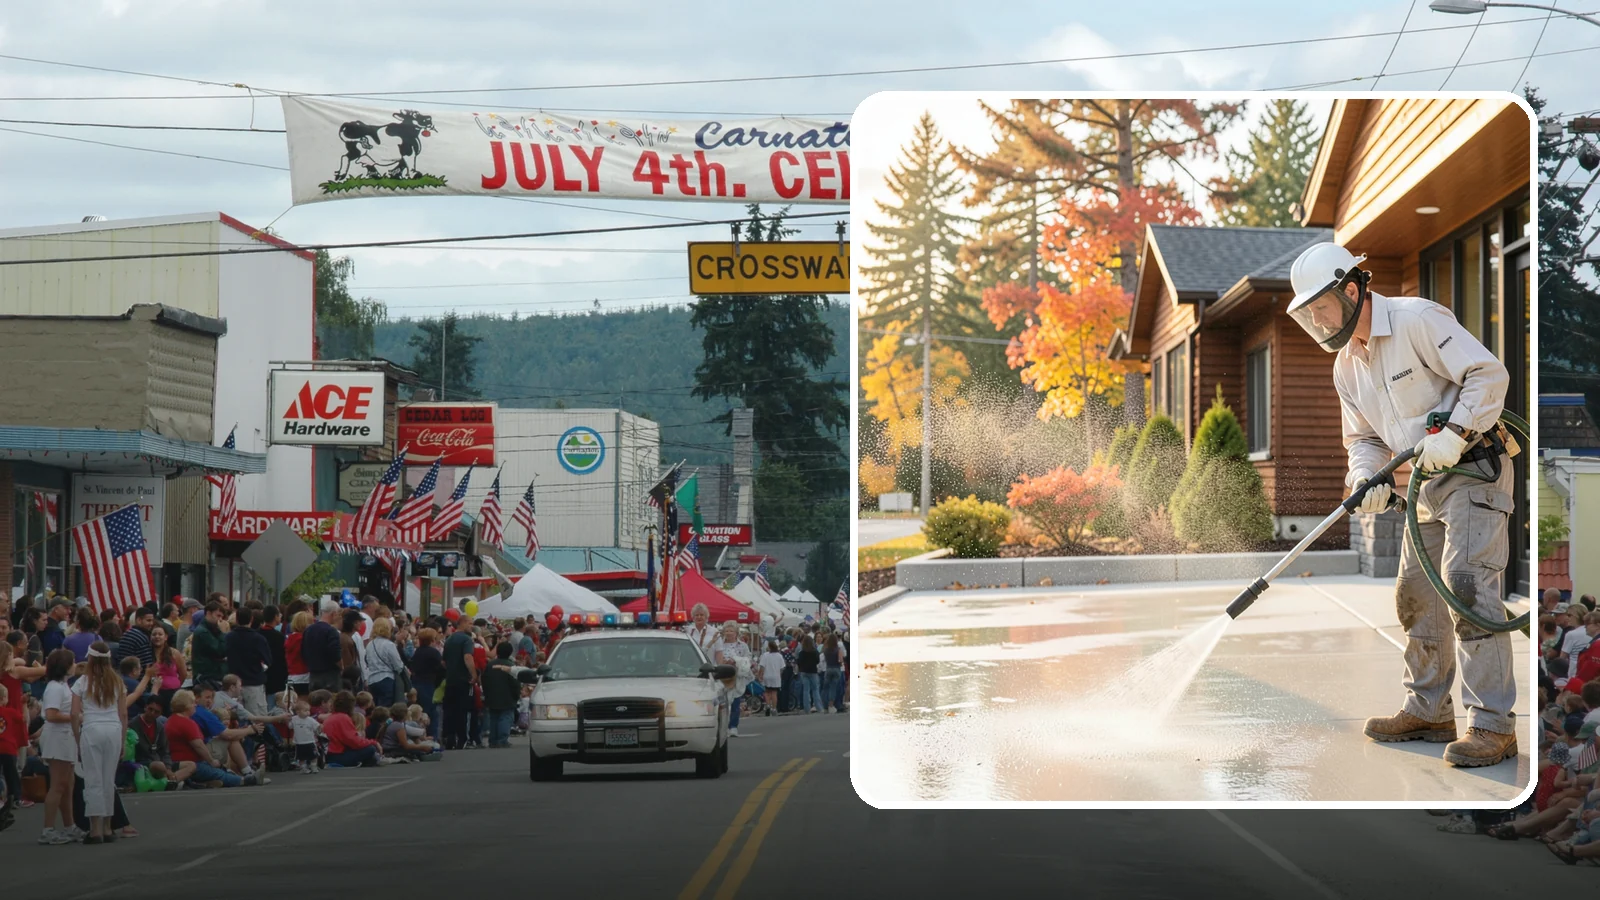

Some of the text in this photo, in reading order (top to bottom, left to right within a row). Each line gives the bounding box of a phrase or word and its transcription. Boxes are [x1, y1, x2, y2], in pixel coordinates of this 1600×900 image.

[481, 141, 605, 192] JULY
[632, 150, 747, 198] 4th.
[697, 254, 850, 280] CROSSWA
[282, 380, 374, 420] ACE
[405, 409, 453, 422] CEDAR
[283, 421, 371, 436] Hardware
[416, 427, 477, 447] Coca-Cola
[83, 484, 155, 496] St. Vincent de Paul
[688, 526, 741, 535] CRNATION
[699, 535, 730, 543] GLASS
